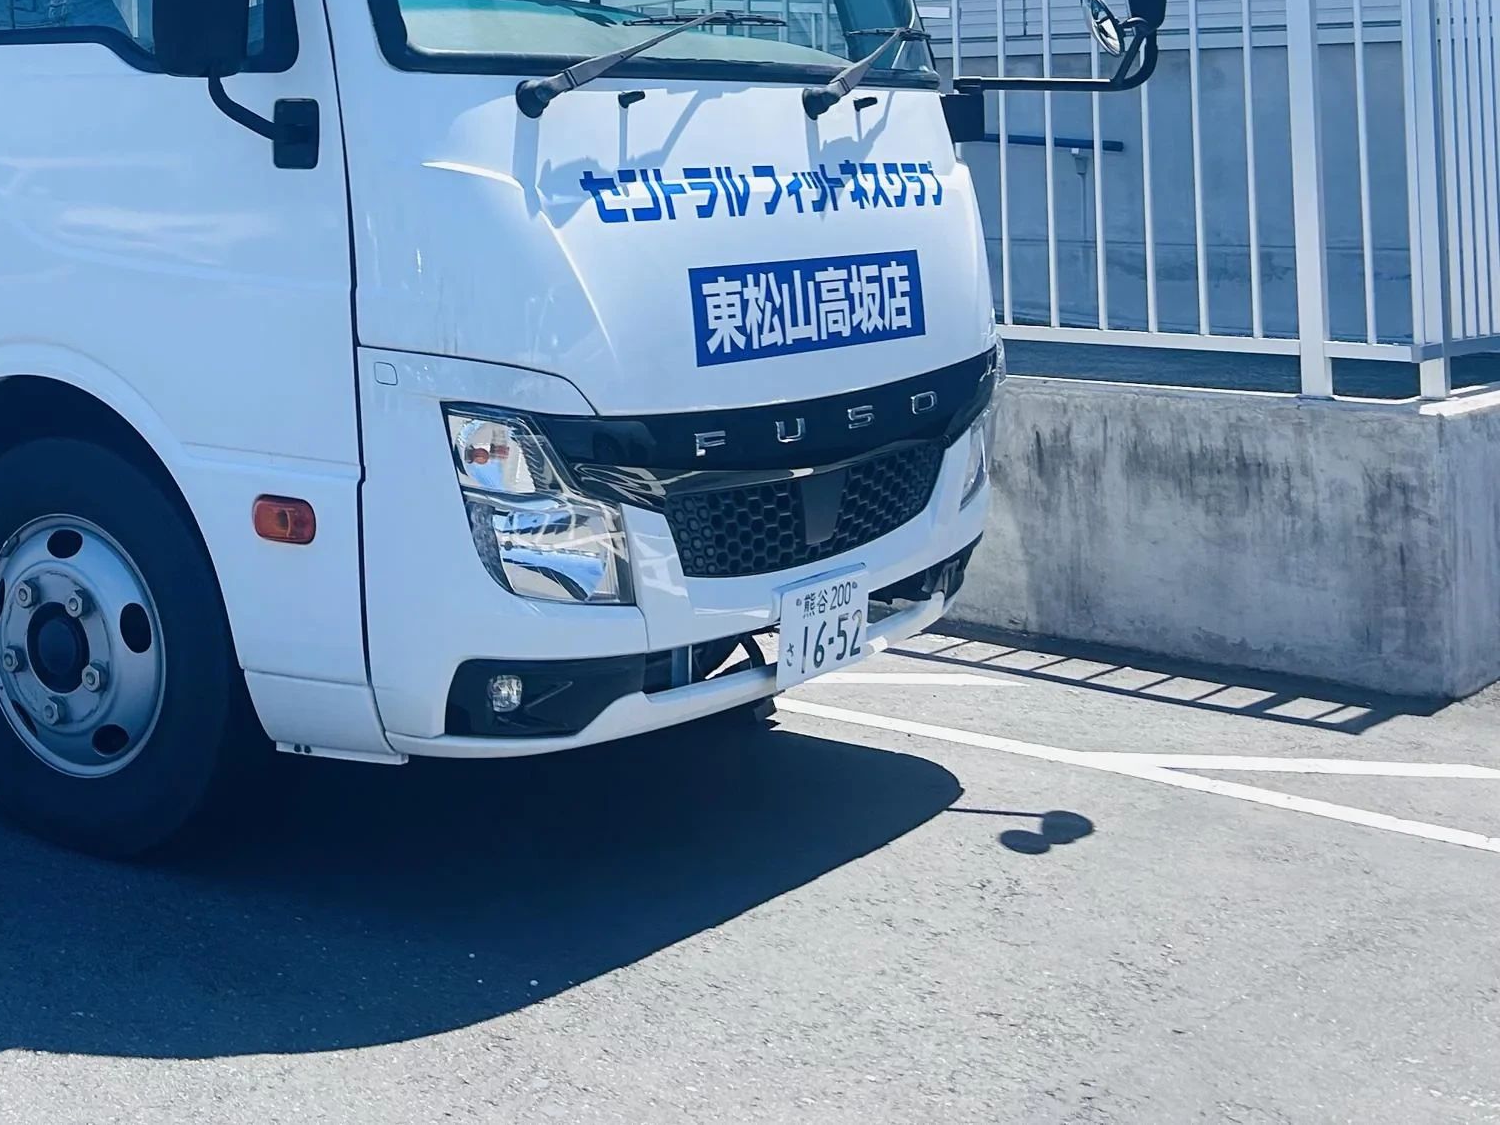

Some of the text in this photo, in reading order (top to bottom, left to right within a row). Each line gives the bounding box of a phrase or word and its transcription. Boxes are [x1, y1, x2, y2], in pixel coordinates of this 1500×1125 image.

[702, 260, 913, 355] 東松山高坂店
[694, 390, 937, 457] FUSO
[786, 642, 795, 667] さ
